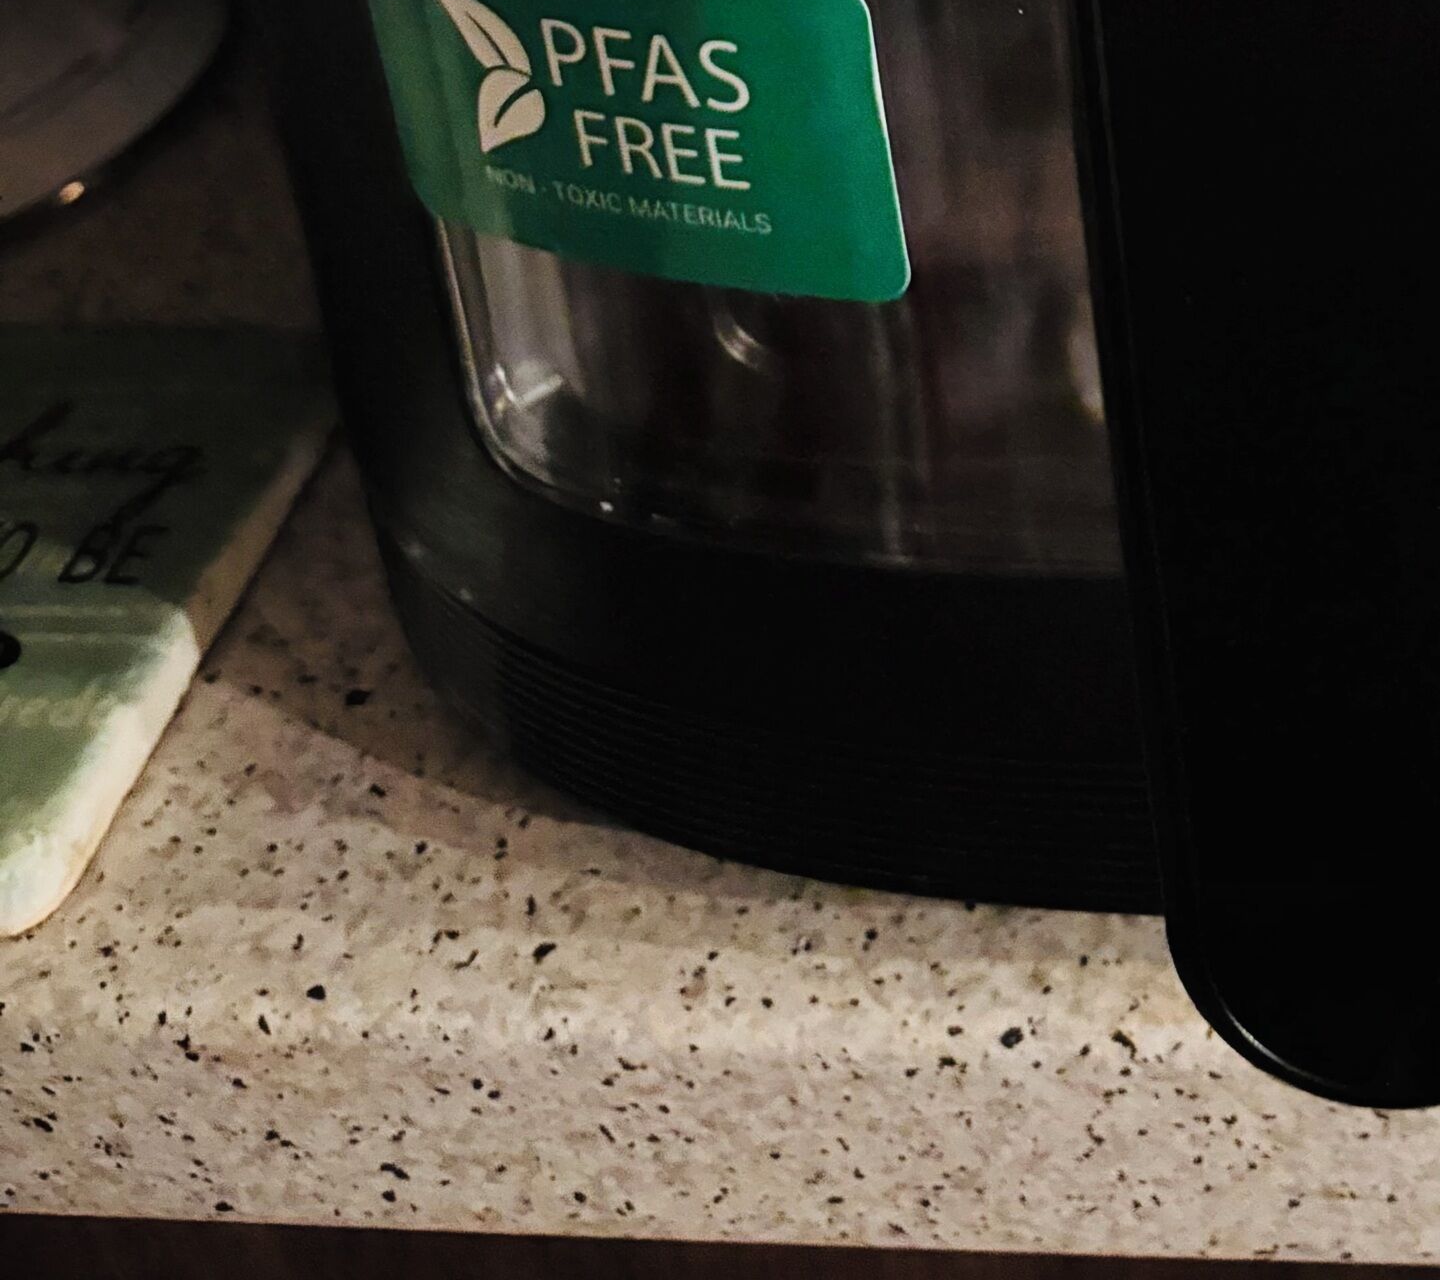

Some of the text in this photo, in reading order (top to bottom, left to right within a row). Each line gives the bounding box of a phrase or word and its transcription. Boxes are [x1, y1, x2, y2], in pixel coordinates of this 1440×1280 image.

[540, 17, 751, 114] PFAS
[573, 108, 752, 192] FREE
[552, 179, 623, 216] TOXIC
[627, 196, 774, 236] MATERIALS
